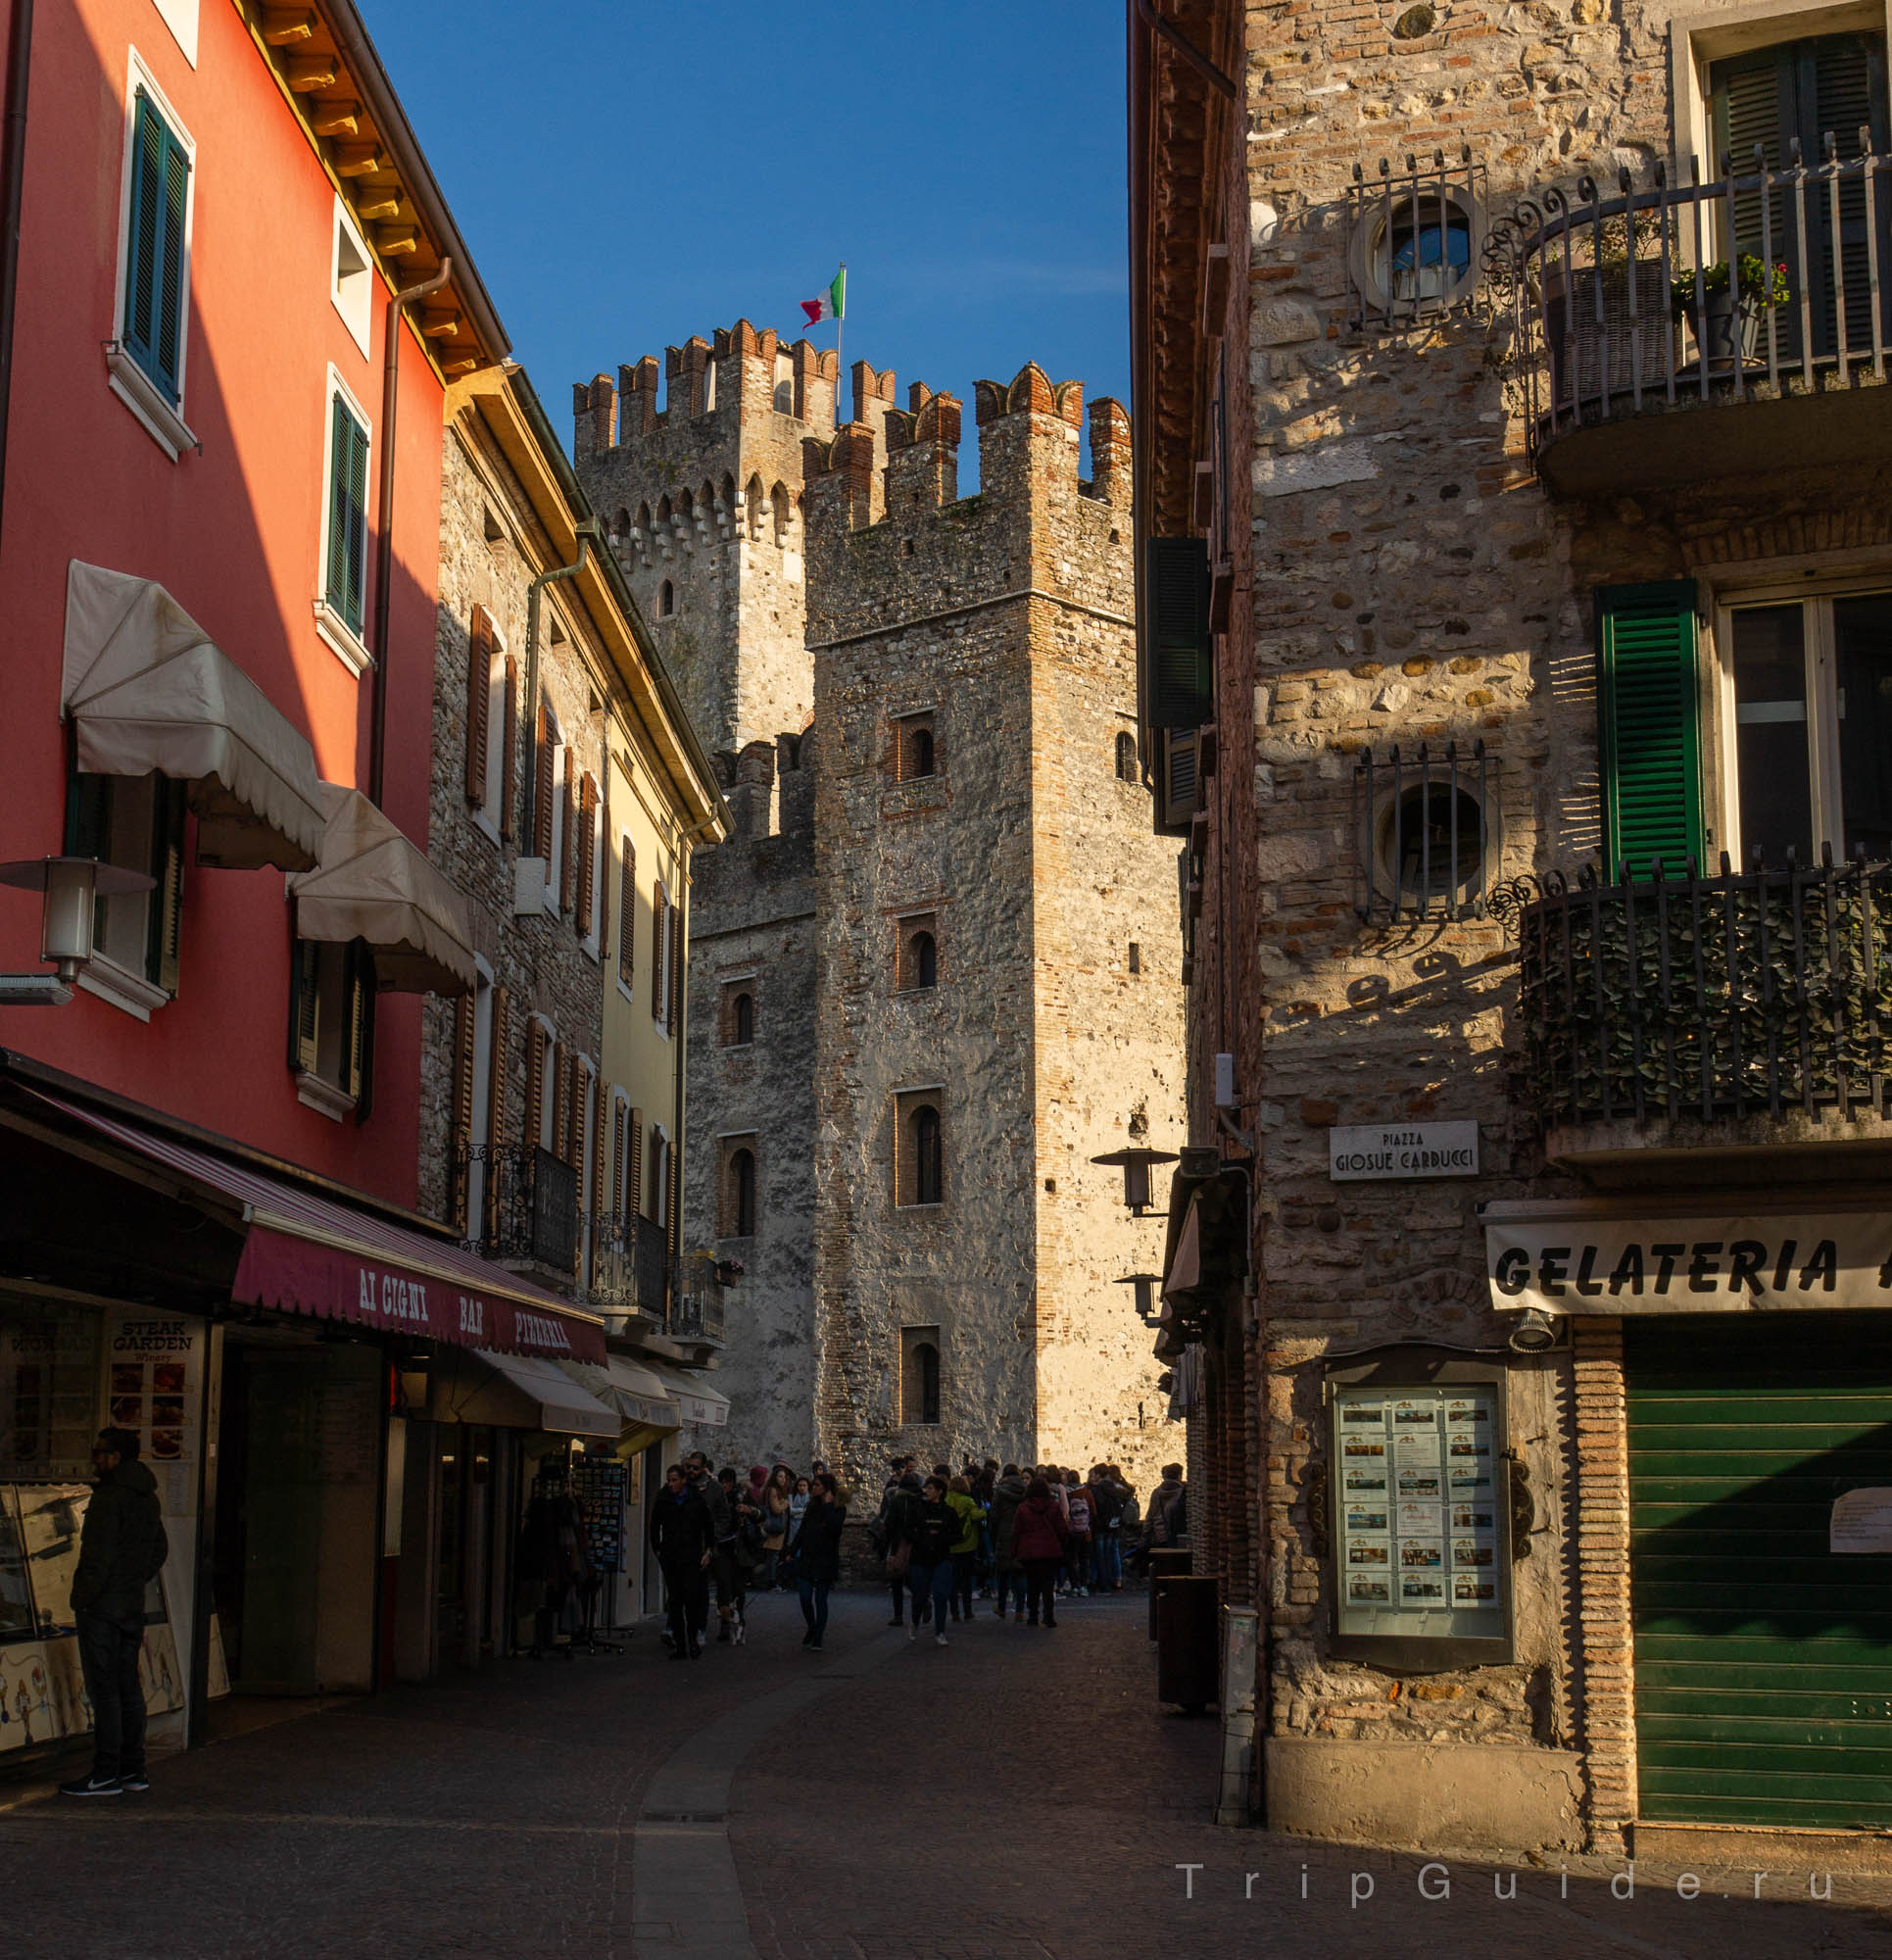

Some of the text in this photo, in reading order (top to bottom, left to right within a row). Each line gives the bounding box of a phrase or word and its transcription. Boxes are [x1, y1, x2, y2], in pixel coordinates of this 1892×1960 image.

[1383, 1133, 1424, 1146] PIAZZA
[1400, 1150, 1474, 1169] CARDUCCI
[1495, 1240, 1837, 1297] GELATERIA
[360, 1268, 571, 1349] AI CIGNI BAR PIZZERIA
[123, 1322, 185, 1335] STEAK
[113, 1338, 193, 1351] GARDEN
[134, 1353, 172, 1363] Winery
